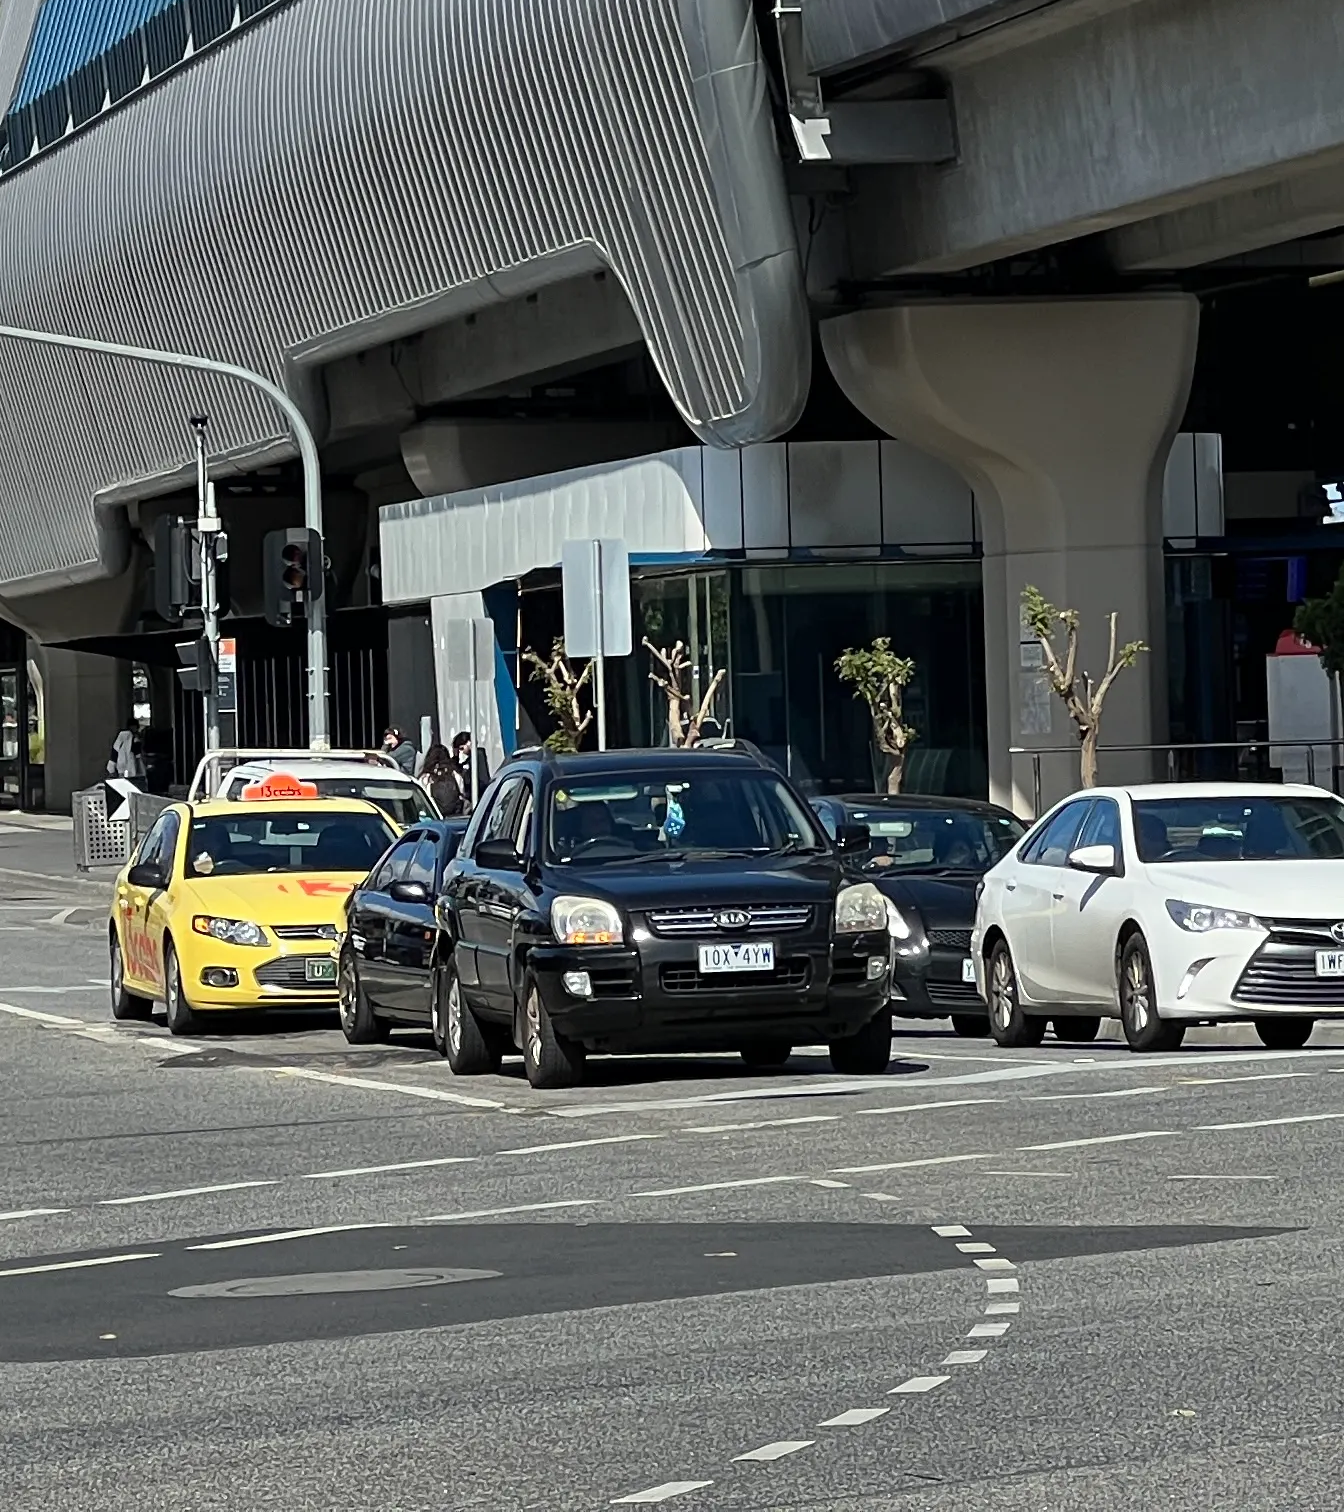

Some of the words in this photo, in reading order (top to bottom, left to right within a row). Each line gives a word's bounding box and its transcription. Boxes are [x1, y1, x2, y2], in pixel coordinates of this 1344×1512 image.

[720, 913, 745, 923] KIA
[742, 947, 771, 964] 4YW
[1321, 954, 1344, 969] 1WF
